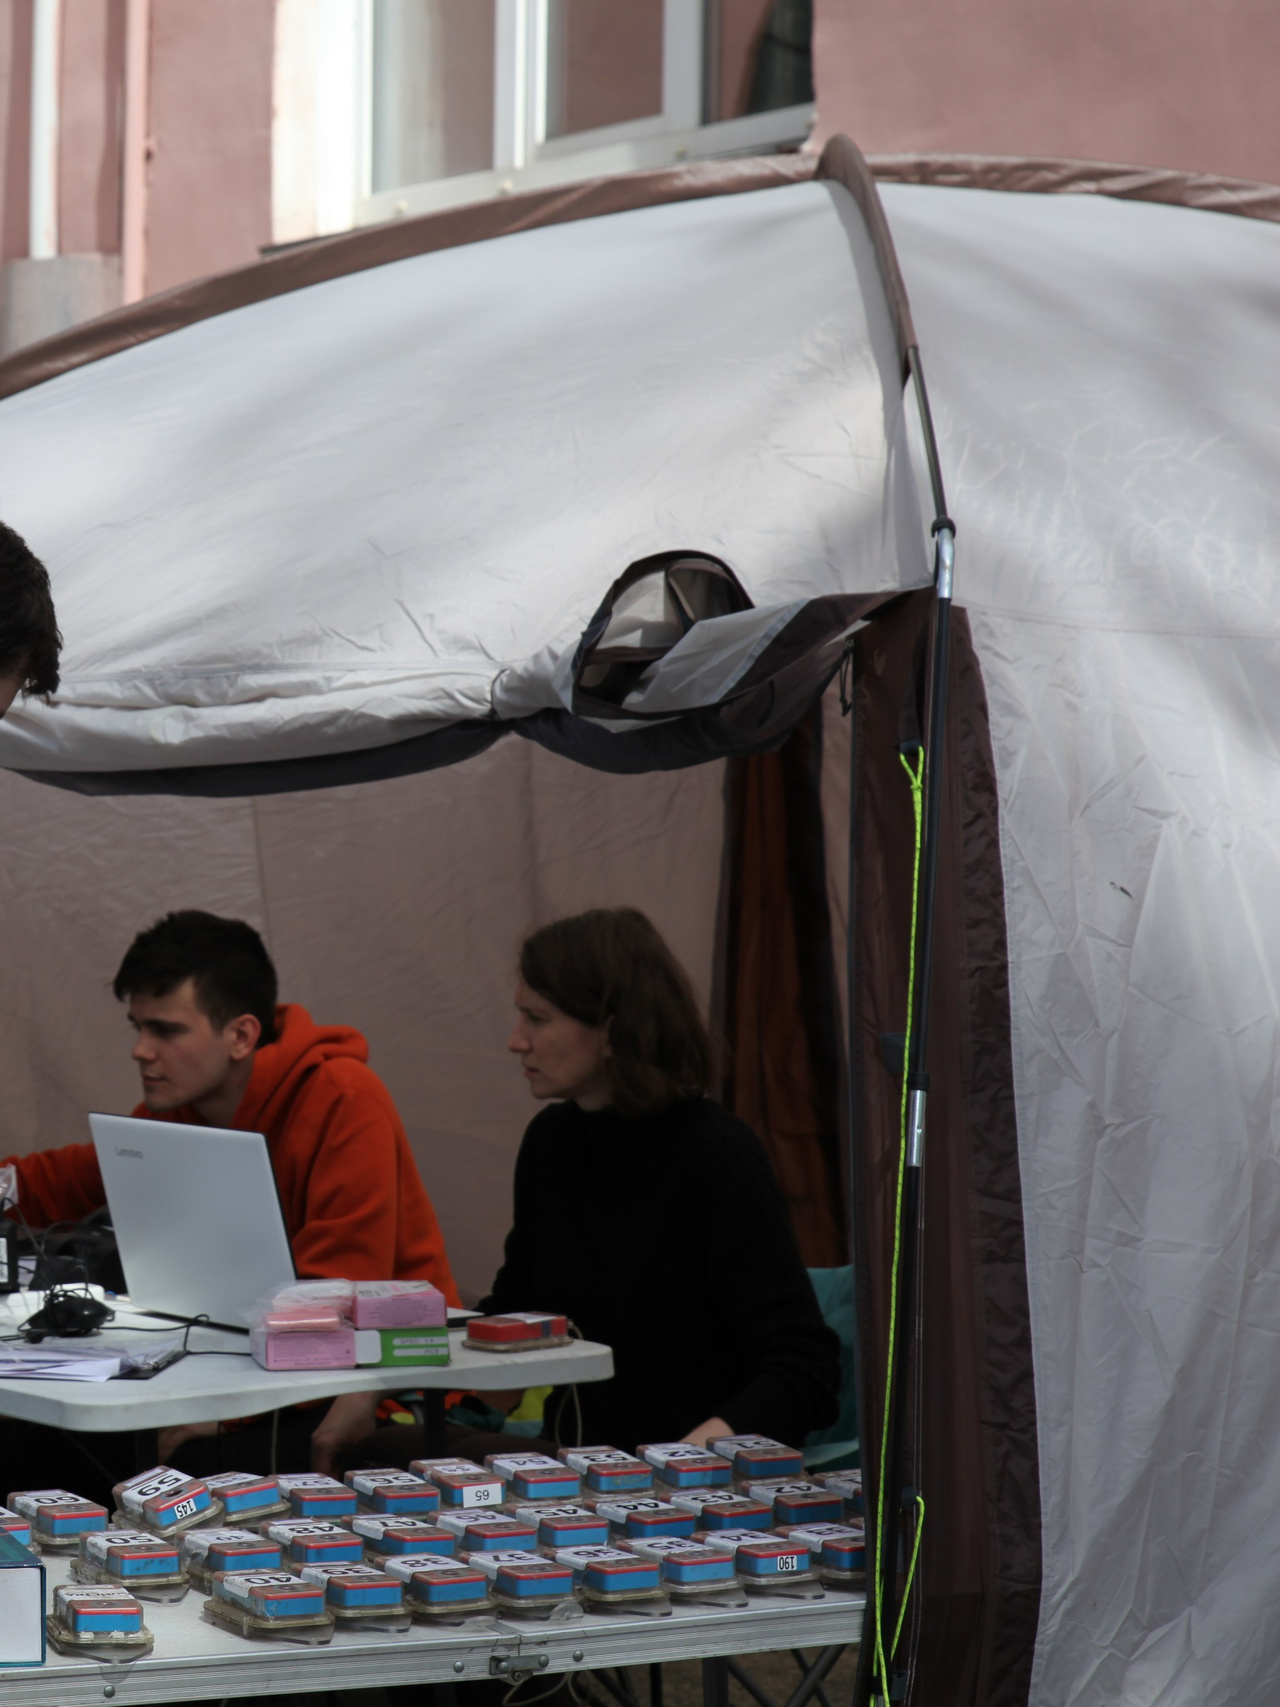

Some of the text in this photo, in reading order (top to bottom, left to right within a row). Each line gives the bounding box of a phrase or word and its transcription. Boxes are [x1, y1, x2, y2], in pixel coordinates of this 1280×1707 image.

[583, 1453, 628, 1463] 53
[137, 1474, 183, 1497] 59
[766, 1485, 812, 1494] 42
[475, 1489, 490, 1502] 65
[691, 1494, 734, 1503] 43
[34, 1496, 80, 1505] 60
[176, 1500, 194, 1518] 145
[616, 1502, 660, 1511] 44
[534, 1508, 578, 1517] 45
[288, 1525, 335, 1535] 48
[105, 1535, 155, 1545] 50
[401, 1559, 450, 1568] 38
[322, 1567, 373, 1575] 39
[244, 1576, 292, 1585] 40
